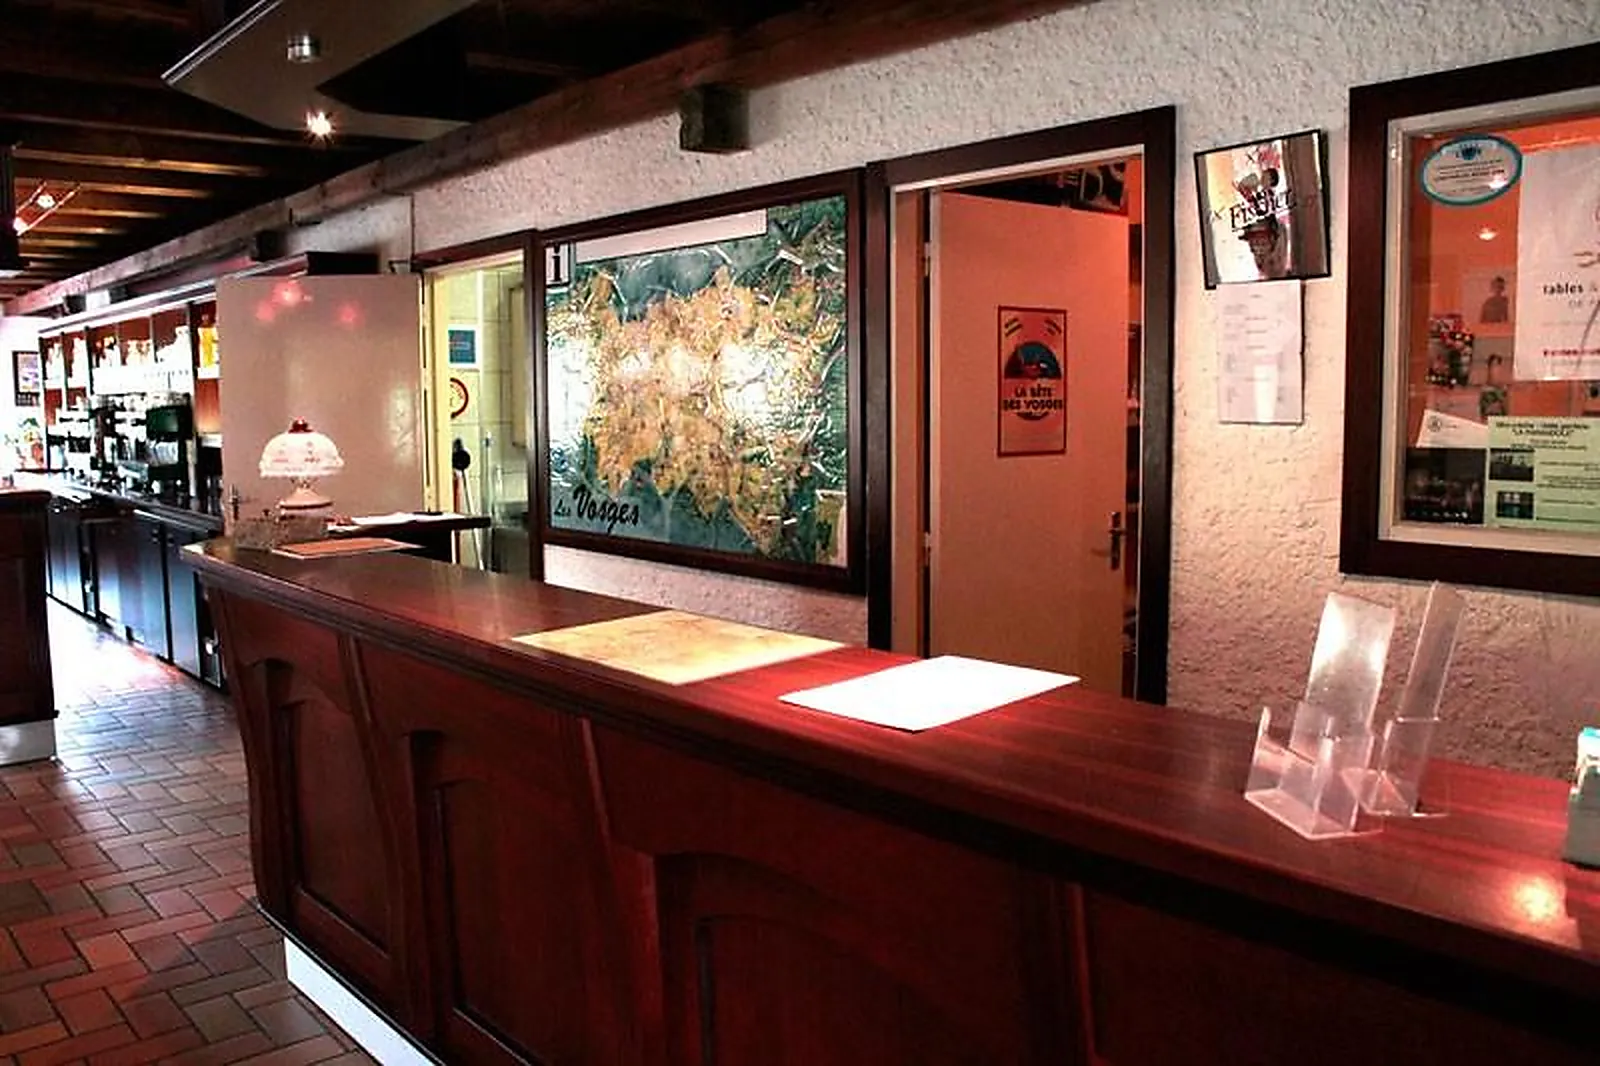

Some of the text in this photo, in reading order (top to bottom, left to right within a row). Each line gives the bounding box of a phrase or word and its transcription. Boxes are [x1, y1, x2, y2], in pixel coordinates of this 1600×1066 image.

[1543, 281, 1584, 295] tables
[1015, 387, 1027, 397] LA
[1023, 399, 1063, 411] VOSGES
[573, 483, 639, 534] Vosges
